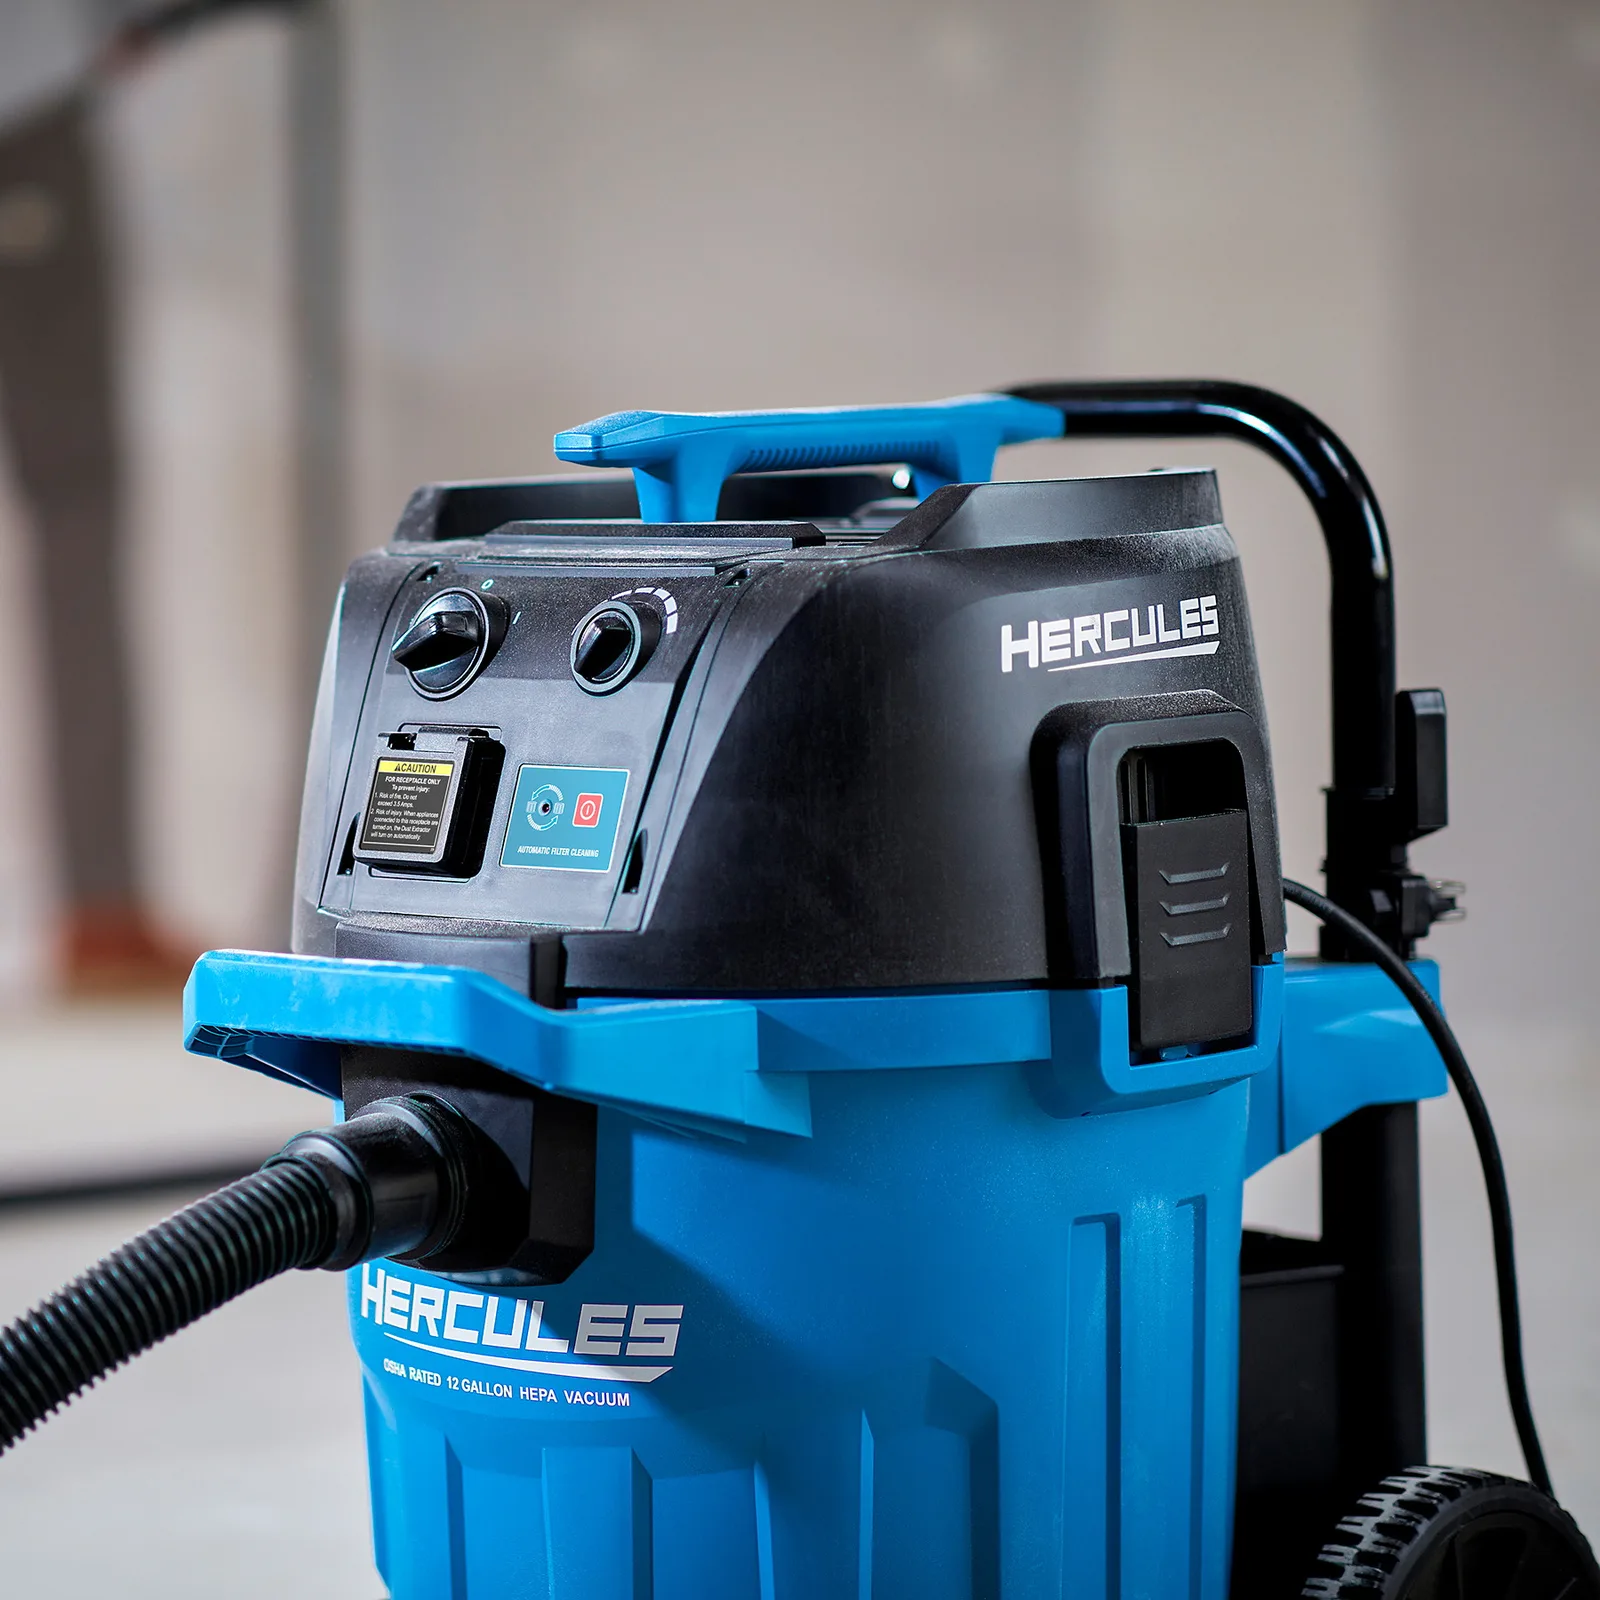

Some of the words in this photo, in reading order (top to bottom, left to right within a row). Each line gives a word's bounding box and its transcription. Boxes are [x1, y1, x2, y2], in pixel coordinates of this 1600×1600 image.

[1001, 595, 1219, 673] HERCULES
[401, 763, 437, 773] CAUTION
[517, 846, 550, 854] AUTOMATIC
[570, 848, 599, 857] CLEANING
[360, 1263, 684, 1357] HERCULES
[383, 1358, 406, 1378] OSHA
[409, 1366, 441, 1387] RATED
[446, 1376, 459, 1391] 12
[461, 1378, 513, 1398] GALLON
[519, 1386, 558, 1403] HEPA
[563, 1390, 630, 1407] VACUUM
